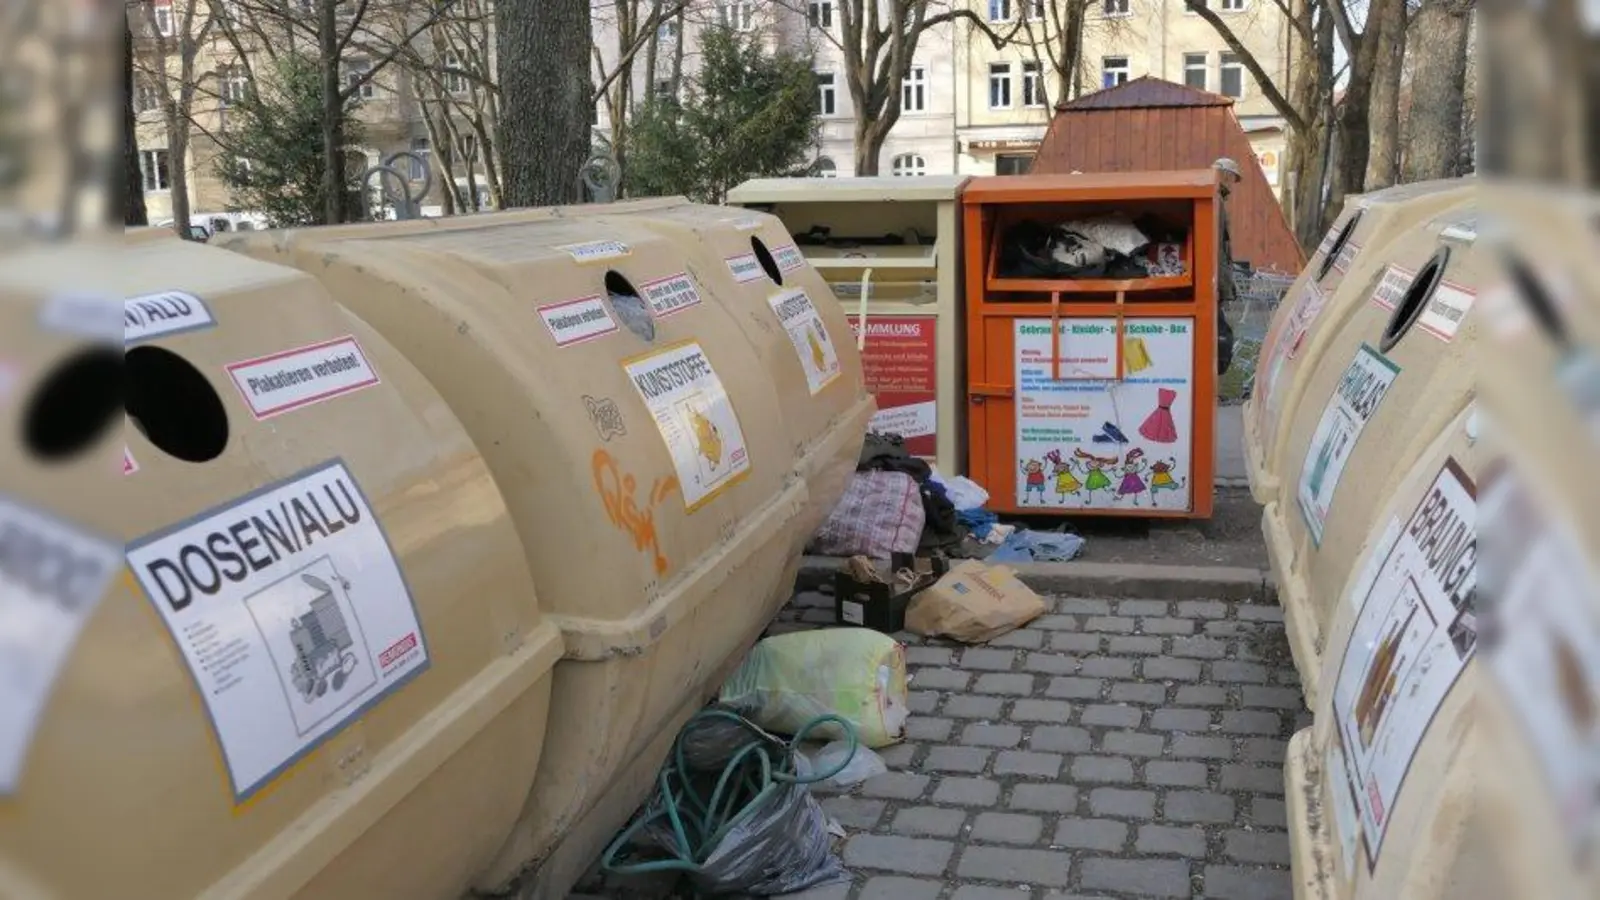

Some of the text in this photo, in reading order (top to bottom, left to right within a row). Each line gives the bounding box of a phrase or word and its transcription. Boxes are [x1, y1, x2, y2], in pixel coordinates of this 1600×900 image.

[246, 351, 361, 397] Plakatieren verboten!
[633, 353, 711, 400] KUNSTSTOFFE
[146, 479, 361, 612] DOSEN/ALU
